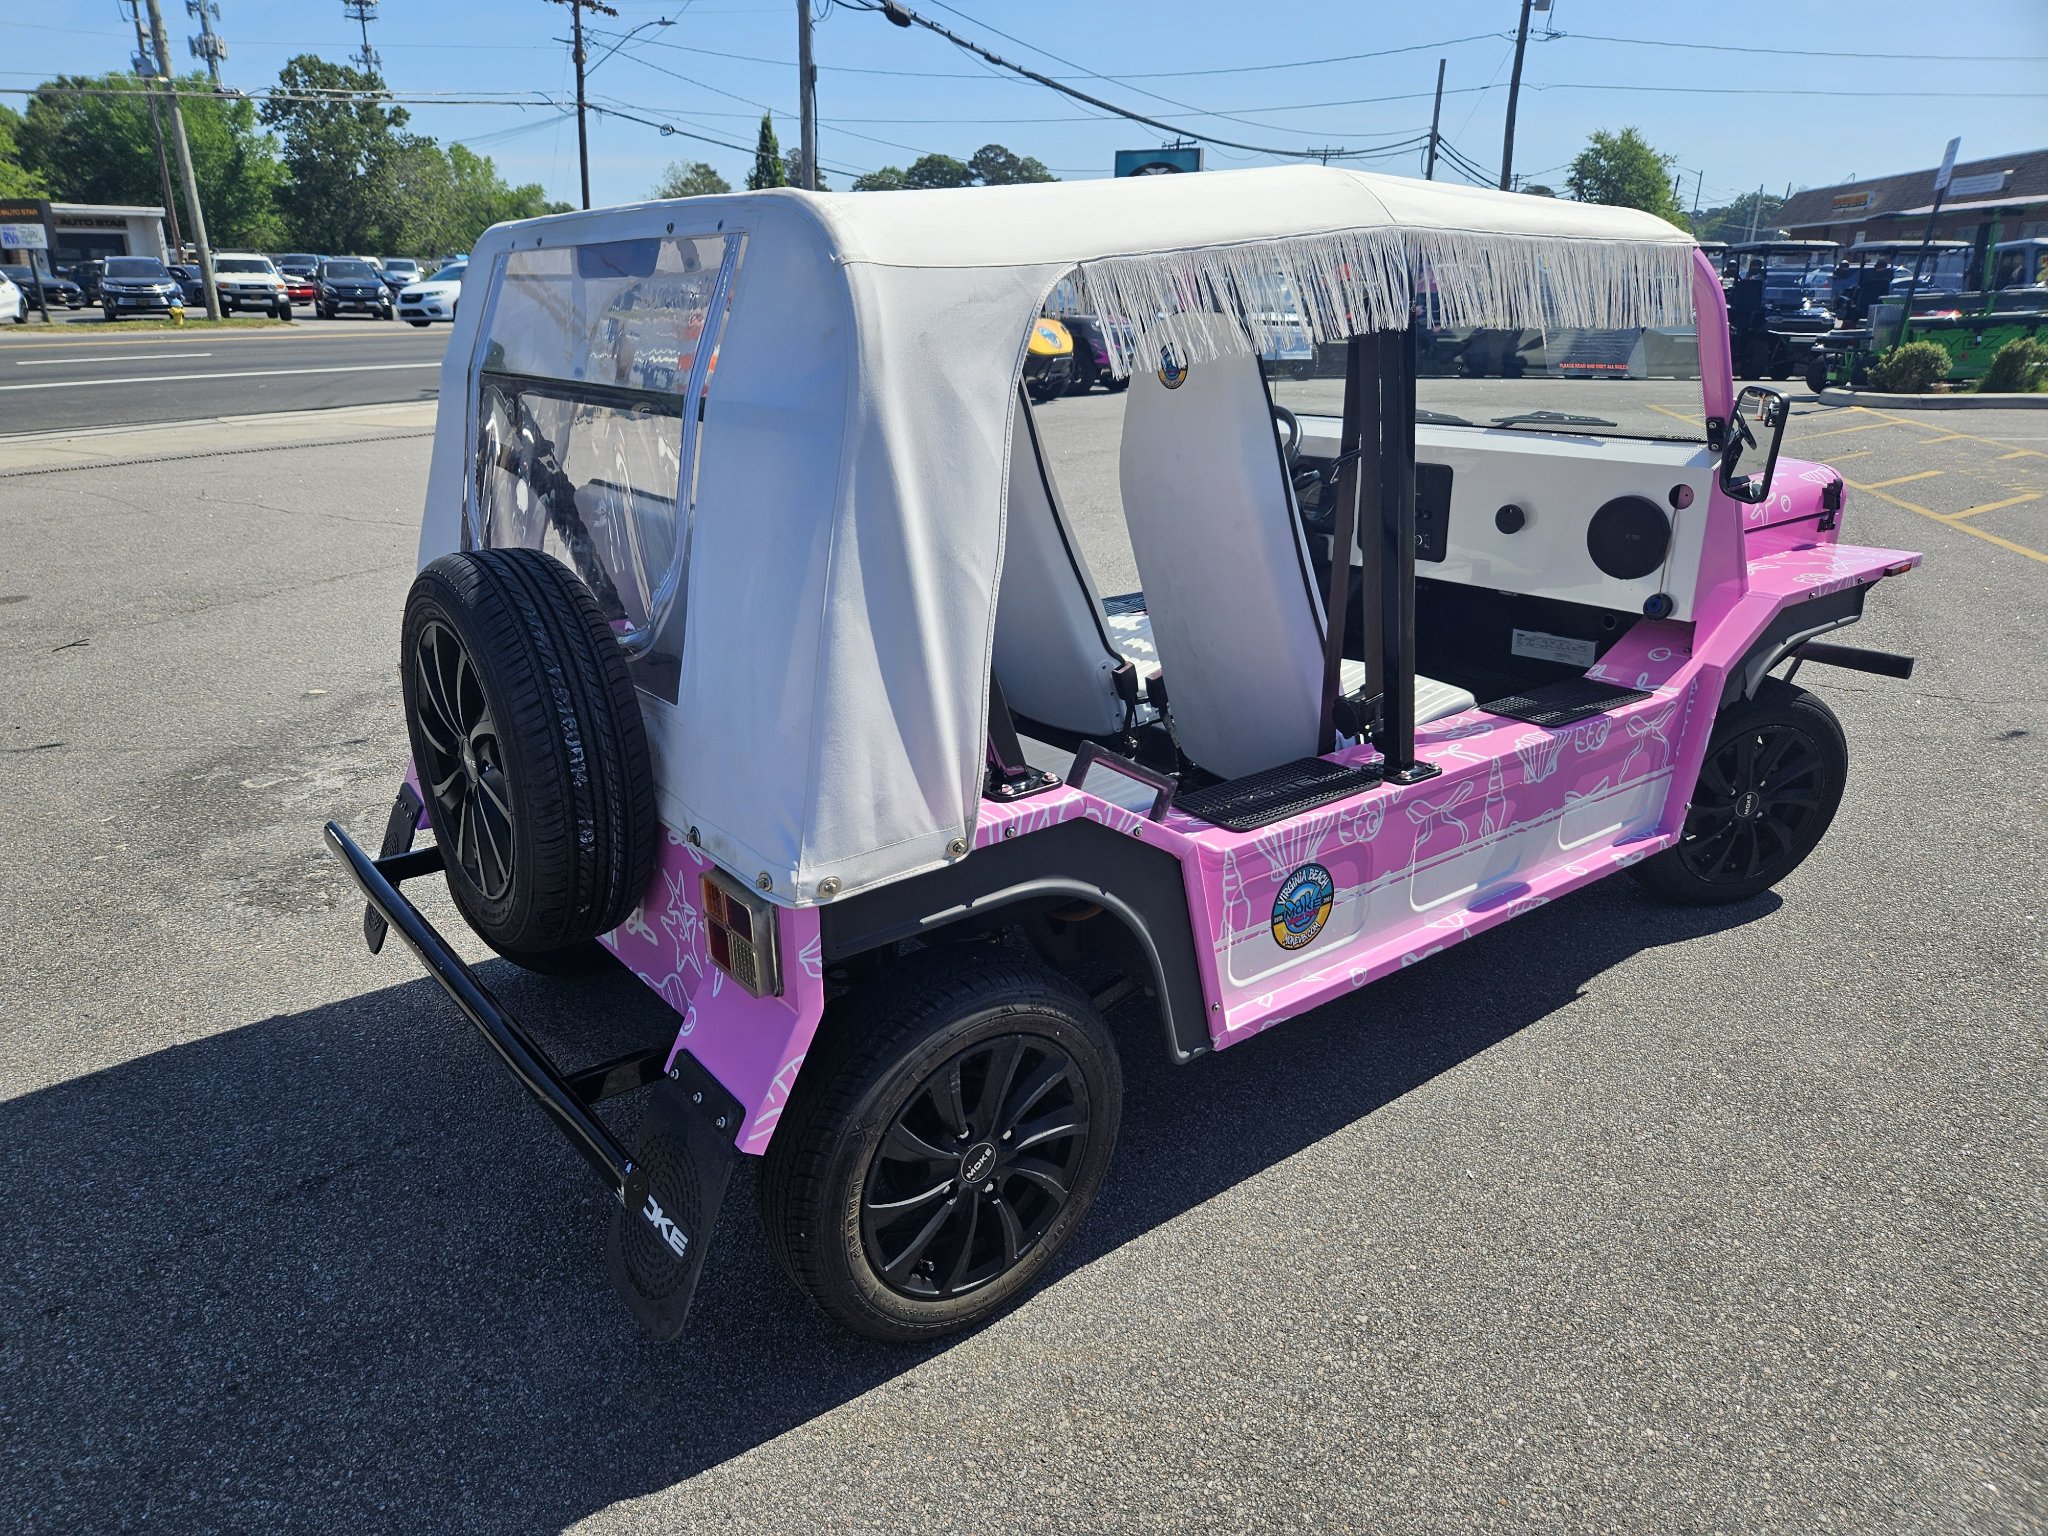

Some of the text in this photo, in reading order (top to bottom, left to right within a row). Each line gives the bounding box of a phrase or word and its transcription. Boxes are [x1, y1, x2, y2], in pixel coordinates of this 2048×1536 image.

[60, 217, 127, 228] AUTO STAR
[1743, 794, 1752, 815] MOKE
[1308, 868, 1330, 890] BEACH
[1285, 897, 1322, 920] MOKE
[965, 1147, 993, 1180] MOKE
[642, 1194, 689, 1258] OKE
